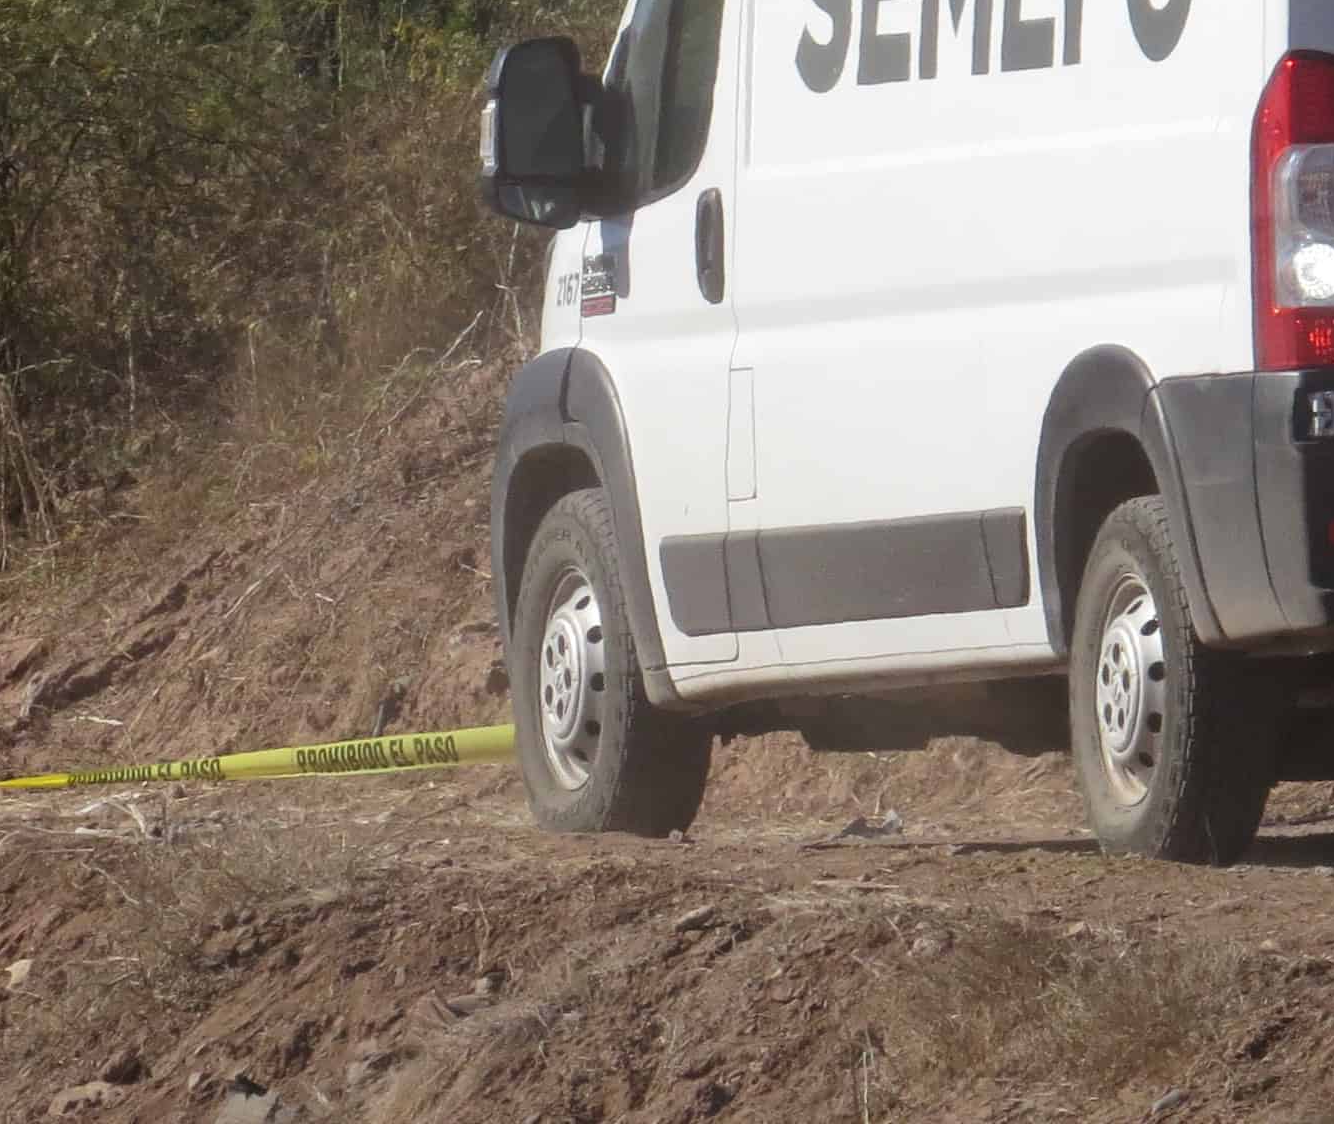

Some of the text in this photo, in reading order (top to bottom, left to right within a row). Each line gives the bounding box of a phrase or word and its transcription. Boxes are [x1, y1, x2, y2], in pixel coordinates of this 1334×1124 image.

[296, 735, 459, 773] PROHIBIDO EL PASO
